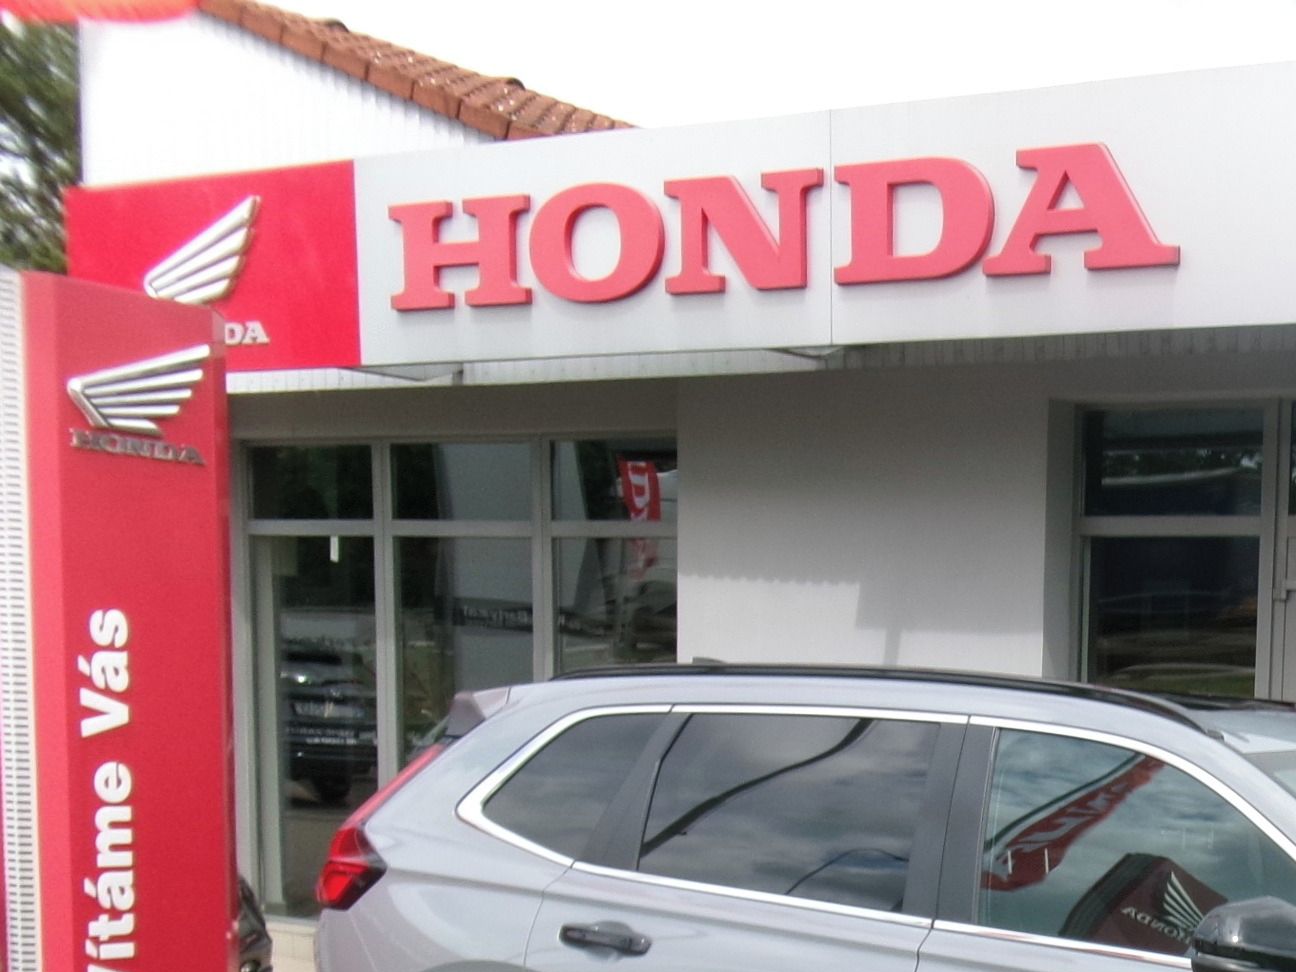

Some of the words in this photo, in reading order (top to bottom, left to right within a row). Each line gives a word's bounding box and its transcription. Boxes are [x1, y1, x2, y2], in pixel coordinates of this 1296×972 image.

[388, 142, 1180, 311] HONDA
[69, 428, 206, 466] HONDA
[77, 608, 130, 738] Vás
